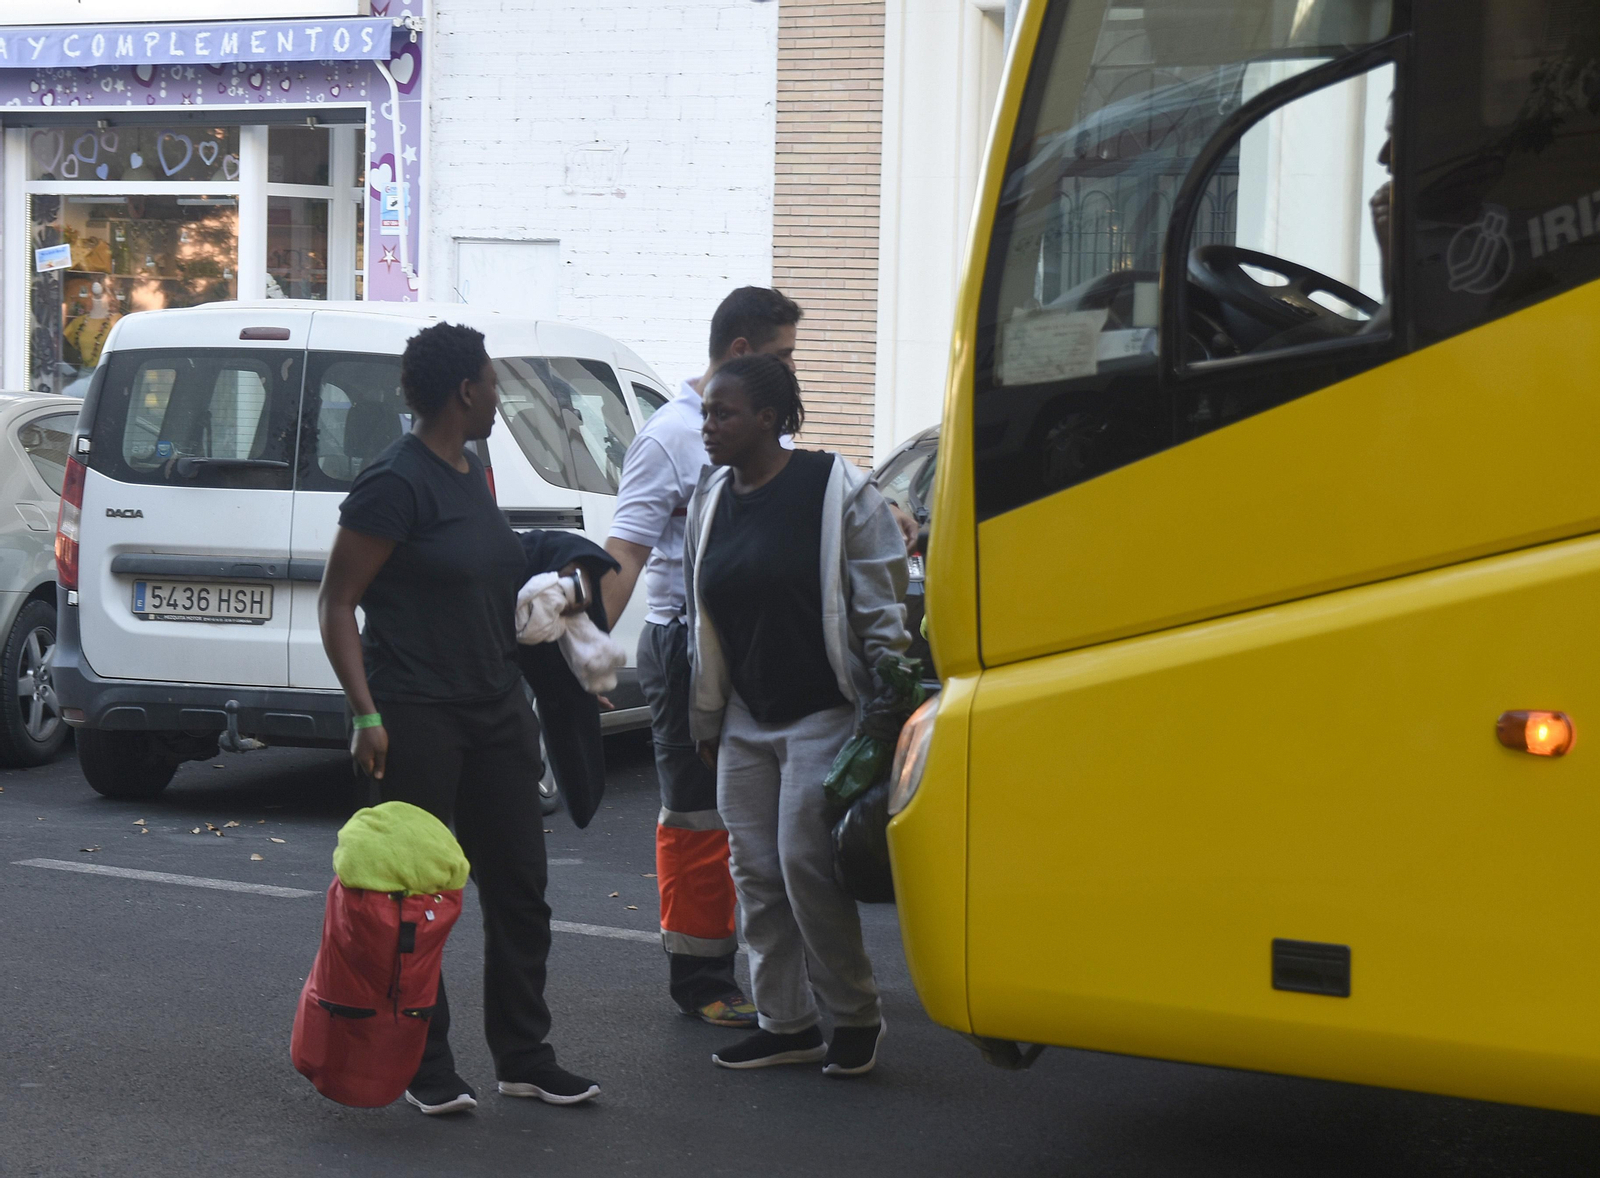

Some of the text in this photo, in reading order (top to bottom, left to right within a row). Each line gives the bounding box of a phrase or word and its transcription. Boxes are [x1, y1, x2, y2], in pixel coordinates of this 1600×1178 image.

[27, 36, 46, 60] Y
[63, 26, 374, 58] COMPLEMENTOS
[1527, 189, 1600, 259] IRI
[105, 508, 144, 518] DACIA
[136, 599, 143, 607] E
[151, 585, 264, 615] 5436 HSH
